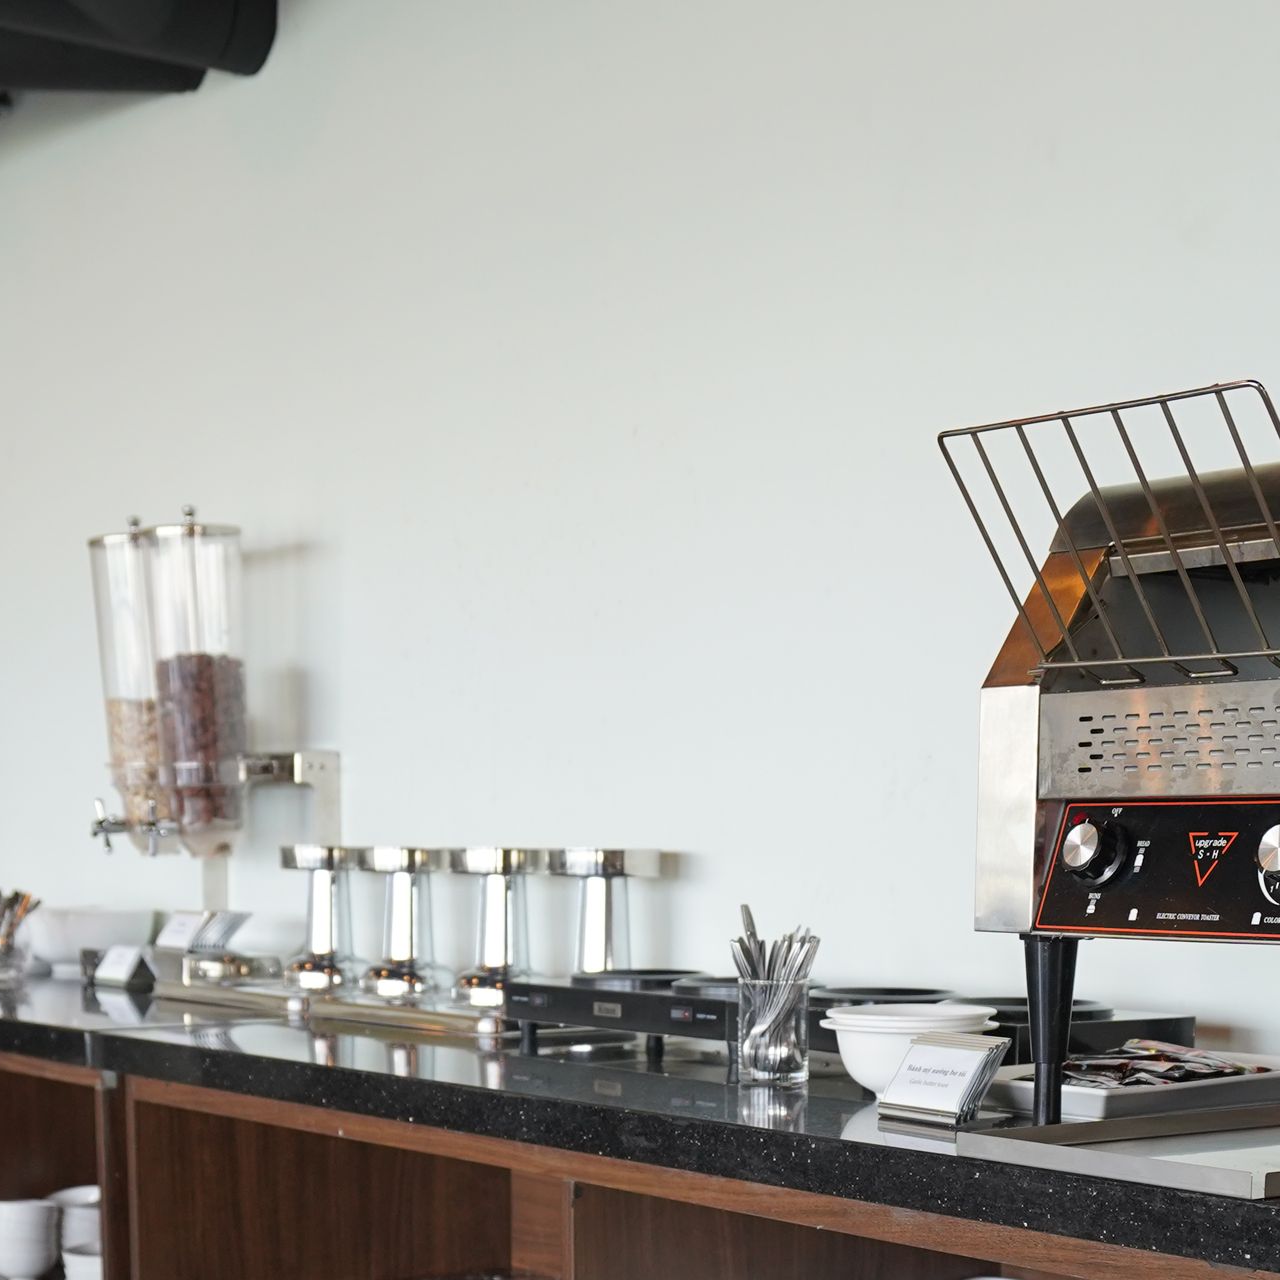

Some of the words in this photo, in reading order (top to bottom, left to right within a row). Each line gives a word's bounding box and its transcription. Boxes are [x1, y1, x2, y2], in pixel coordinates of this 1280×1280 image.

[1111, 807, 1123, 815] OFF
[1195, 838, 1227, 848] upgrade
[1263, 916, 1280, 924] COLOR
